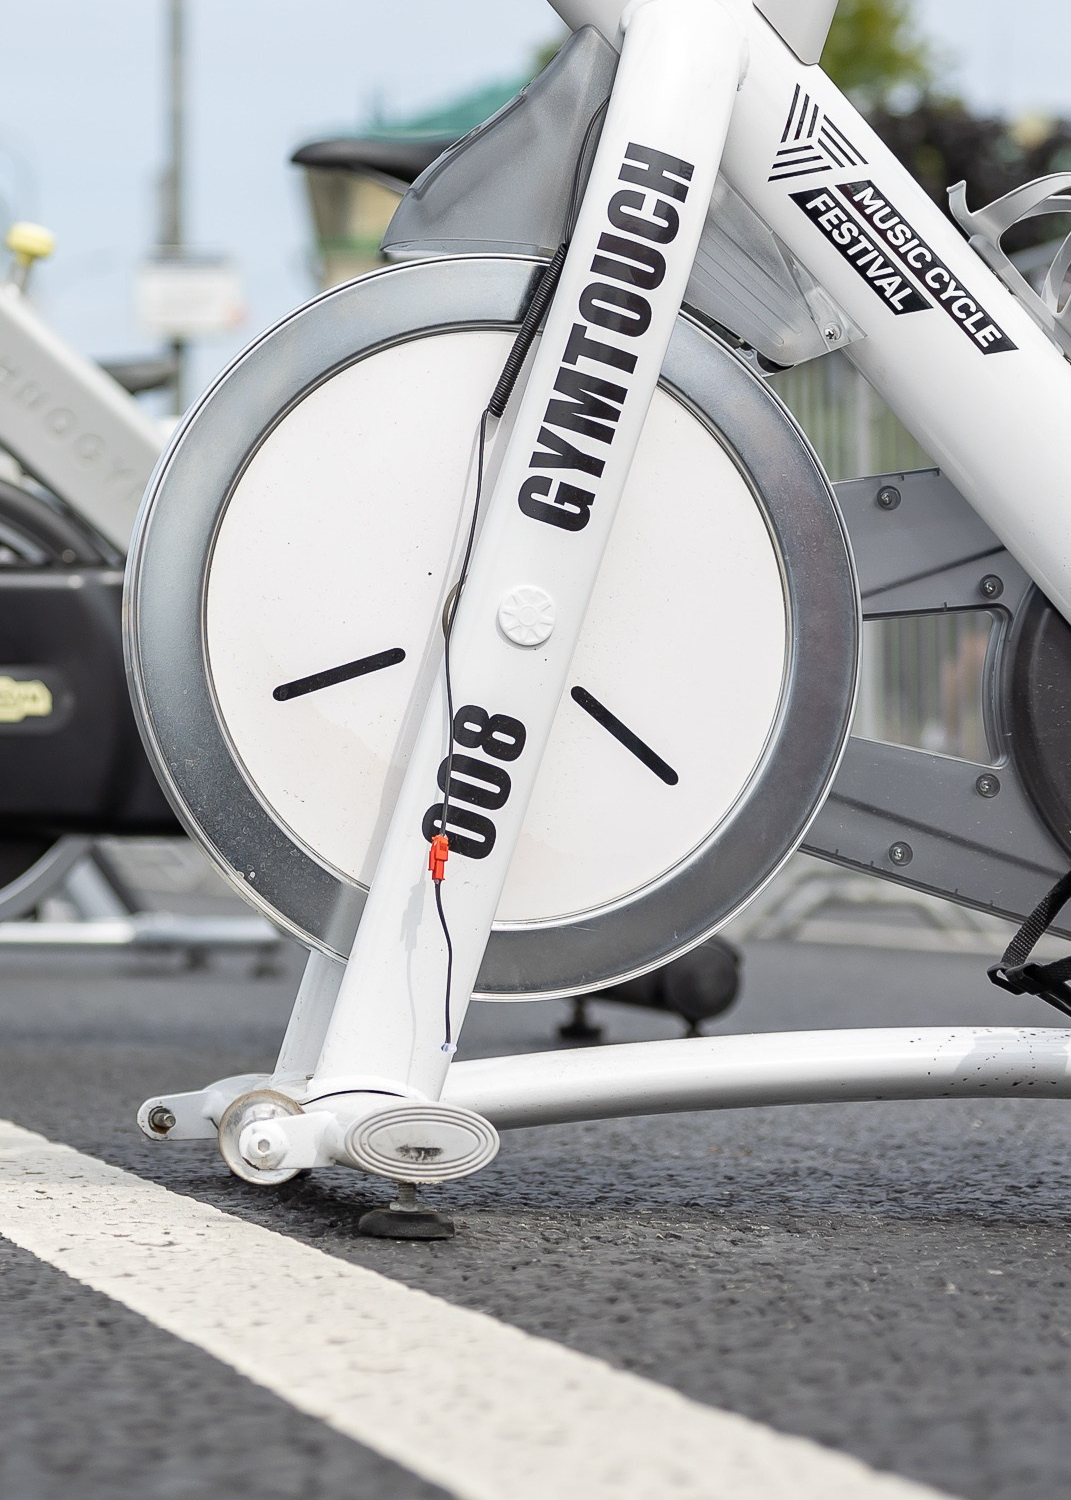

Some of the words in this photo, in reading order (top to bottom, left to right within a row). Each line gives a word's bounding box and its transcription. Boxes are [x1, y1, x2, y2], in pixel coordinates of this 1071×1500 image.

[805, 193, 913, 311] FESTIVAL
[852, 186, 932, 269] MUSIC
[925, 267, 1003, 348] CYCLE
[518, 142, 695, 532] GYMTOUCH
[422, 705, 526, 859] 008
